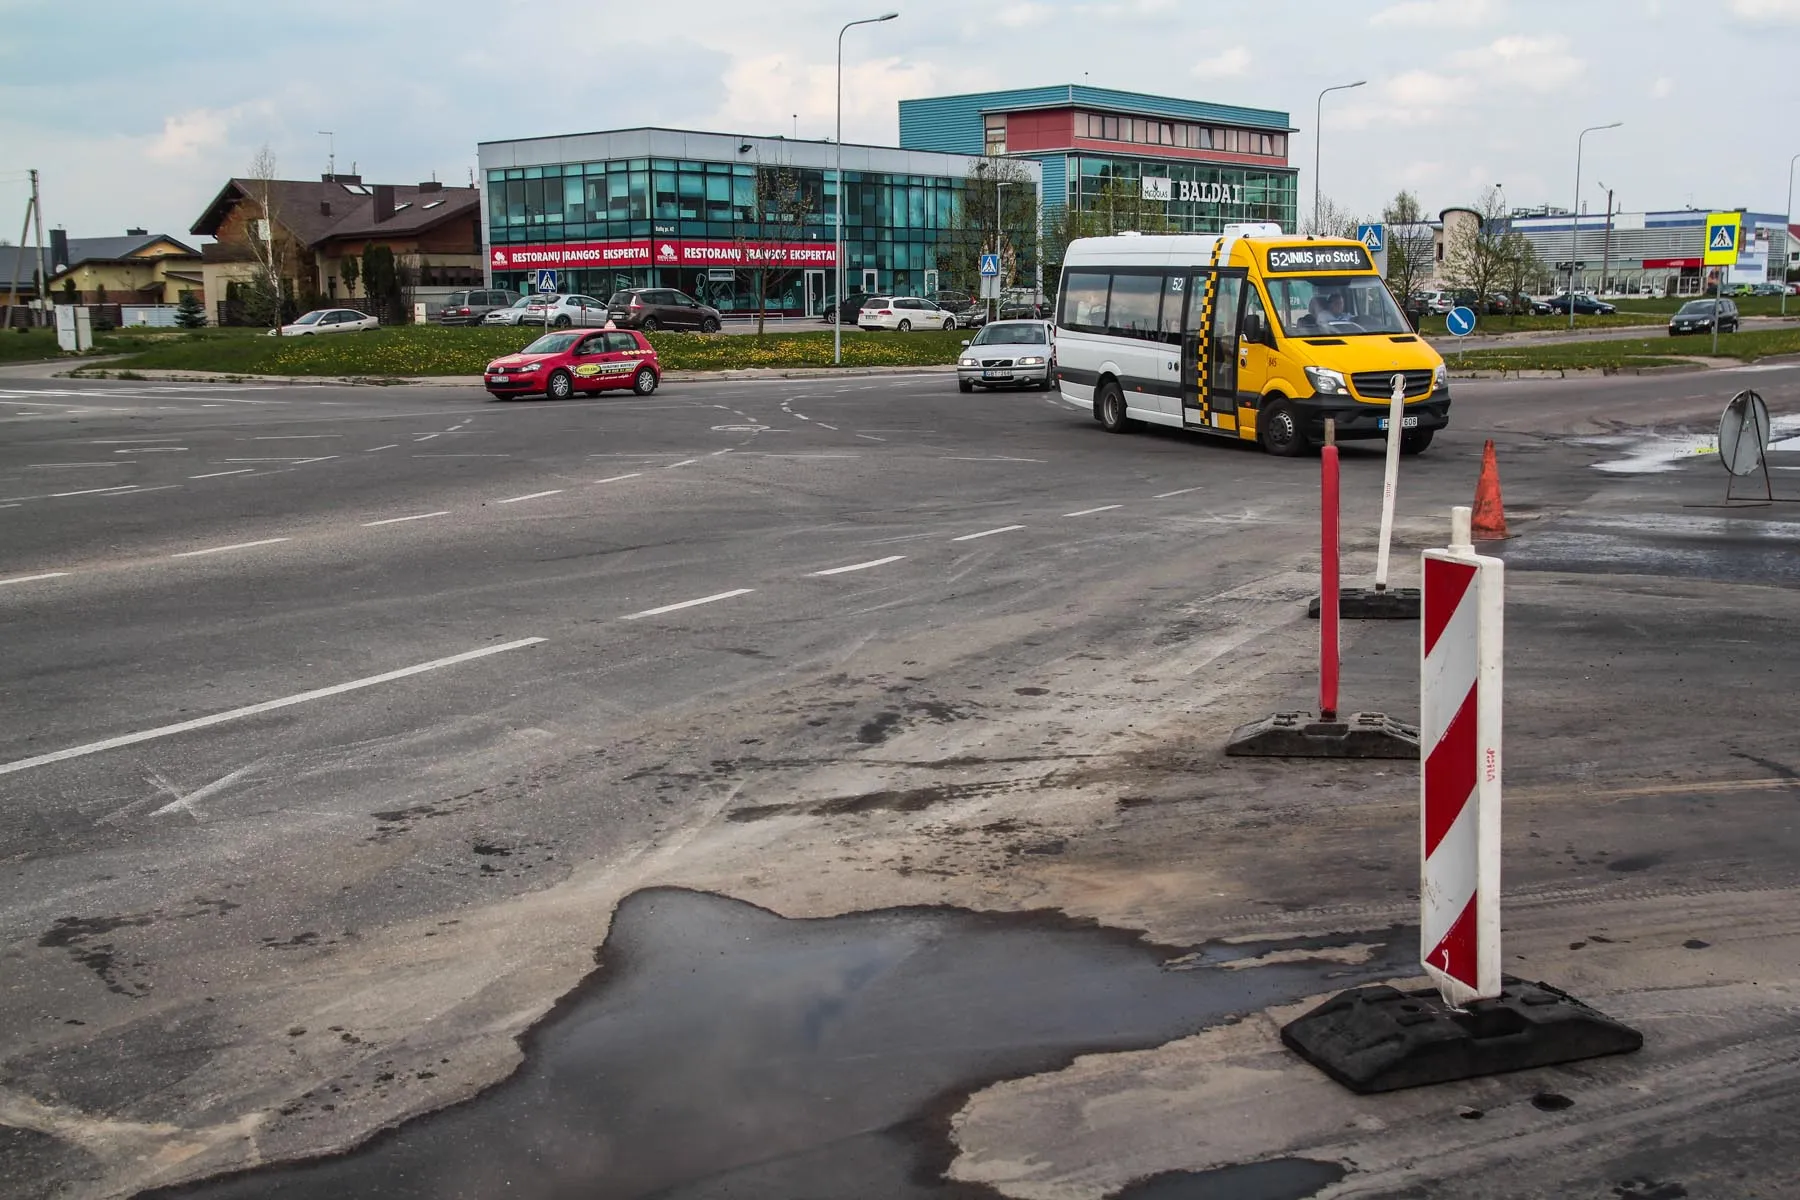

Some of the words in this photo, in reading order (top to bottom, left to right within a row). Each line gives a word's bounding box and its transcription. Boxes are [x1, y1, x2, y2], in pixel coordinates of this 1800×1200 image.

[1179, 180, 1241, 204] BALDAI
[512, 252, 560, 263] RESTORANŲ
[562, 249, 600, 263] ĮRANGOS
[603, 247, 649, 260] EKSPERTAI
[684, 247, 741, 262] RESTORANŲ
[790, 249, 836, 261] EKSPERTAI
[1270, 252, 1289, 266] 52
[1315, 254, 1331, 266] pro
[1172, 277, 1184, 291] 52
